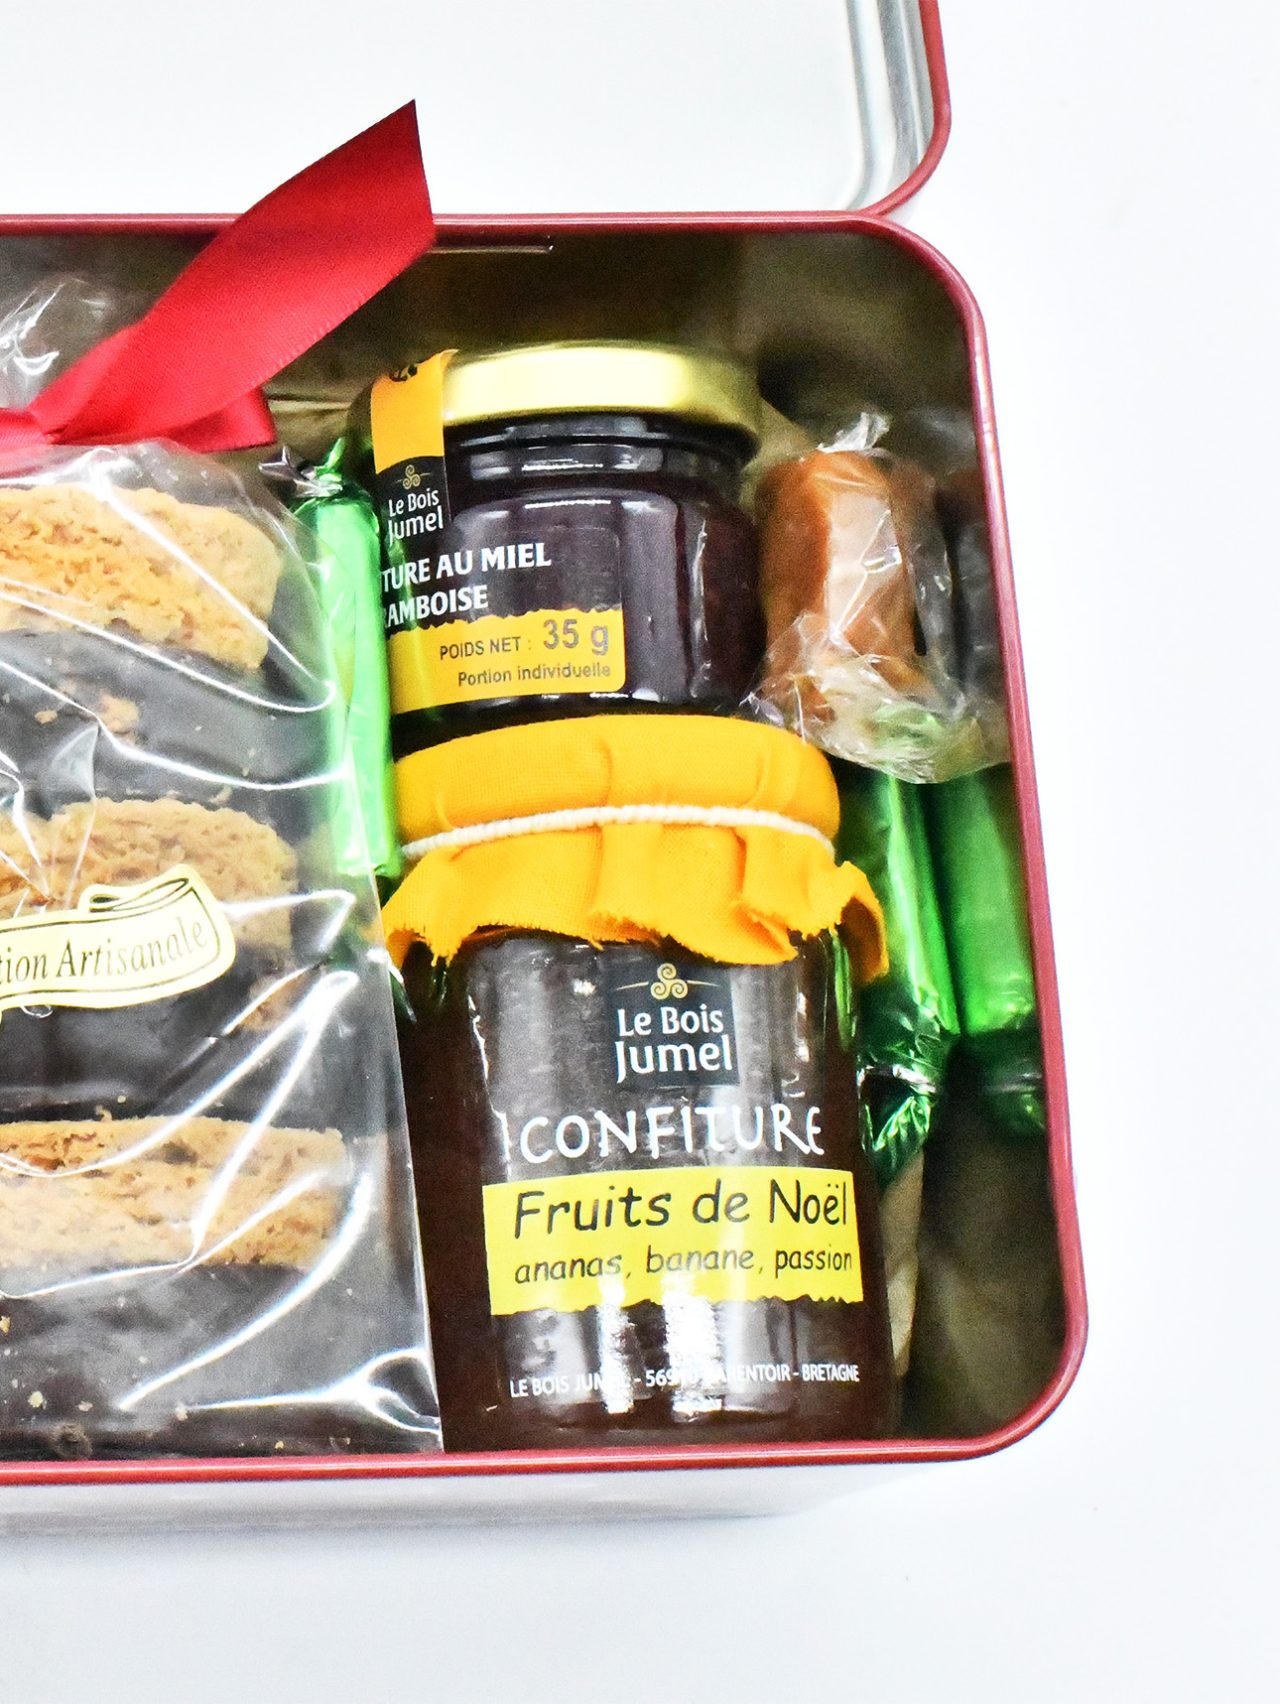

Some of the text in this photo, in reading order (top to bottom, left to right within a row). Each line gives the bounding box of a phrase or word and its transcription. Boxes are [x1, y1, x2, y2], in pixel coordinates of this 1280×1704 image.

[388, 488, 439, 517] Le Bois
[387, 506, 444, 547] Jumel
[436, 550, 473, 579] AU
[481, 542, 552, 572] MIEL
[384, 584, 489, 628] AMBOISE
[439, 638, 485, 661] POIDS
[489, 636, 521, 654] NET
[542, 618, 580, 650] 35
[591, 623, 610, 657] g
[458, 661, 611, 687] Portion individuelle
[55, 919, 207, 979] Artisanale
[617, 1003, 724, 1037] Le Bois
[614, 1034, 733, 1083] Jumel
[519, 1100, 825, 1164] CONFITURE
[514, 1178, 848, 1239] Fruits de Noël
[514, 1244, 853, 1285] ananas, banane, passion
[509, 1379, 529, 1398] LE
[532, 1377, 569, 1396] BOIS
[645, 1367, 698, 1388] 569
[704, 1363, 792, 1383] RENTOIR
[801, 1363, 861, 1383] BRETAGNE
